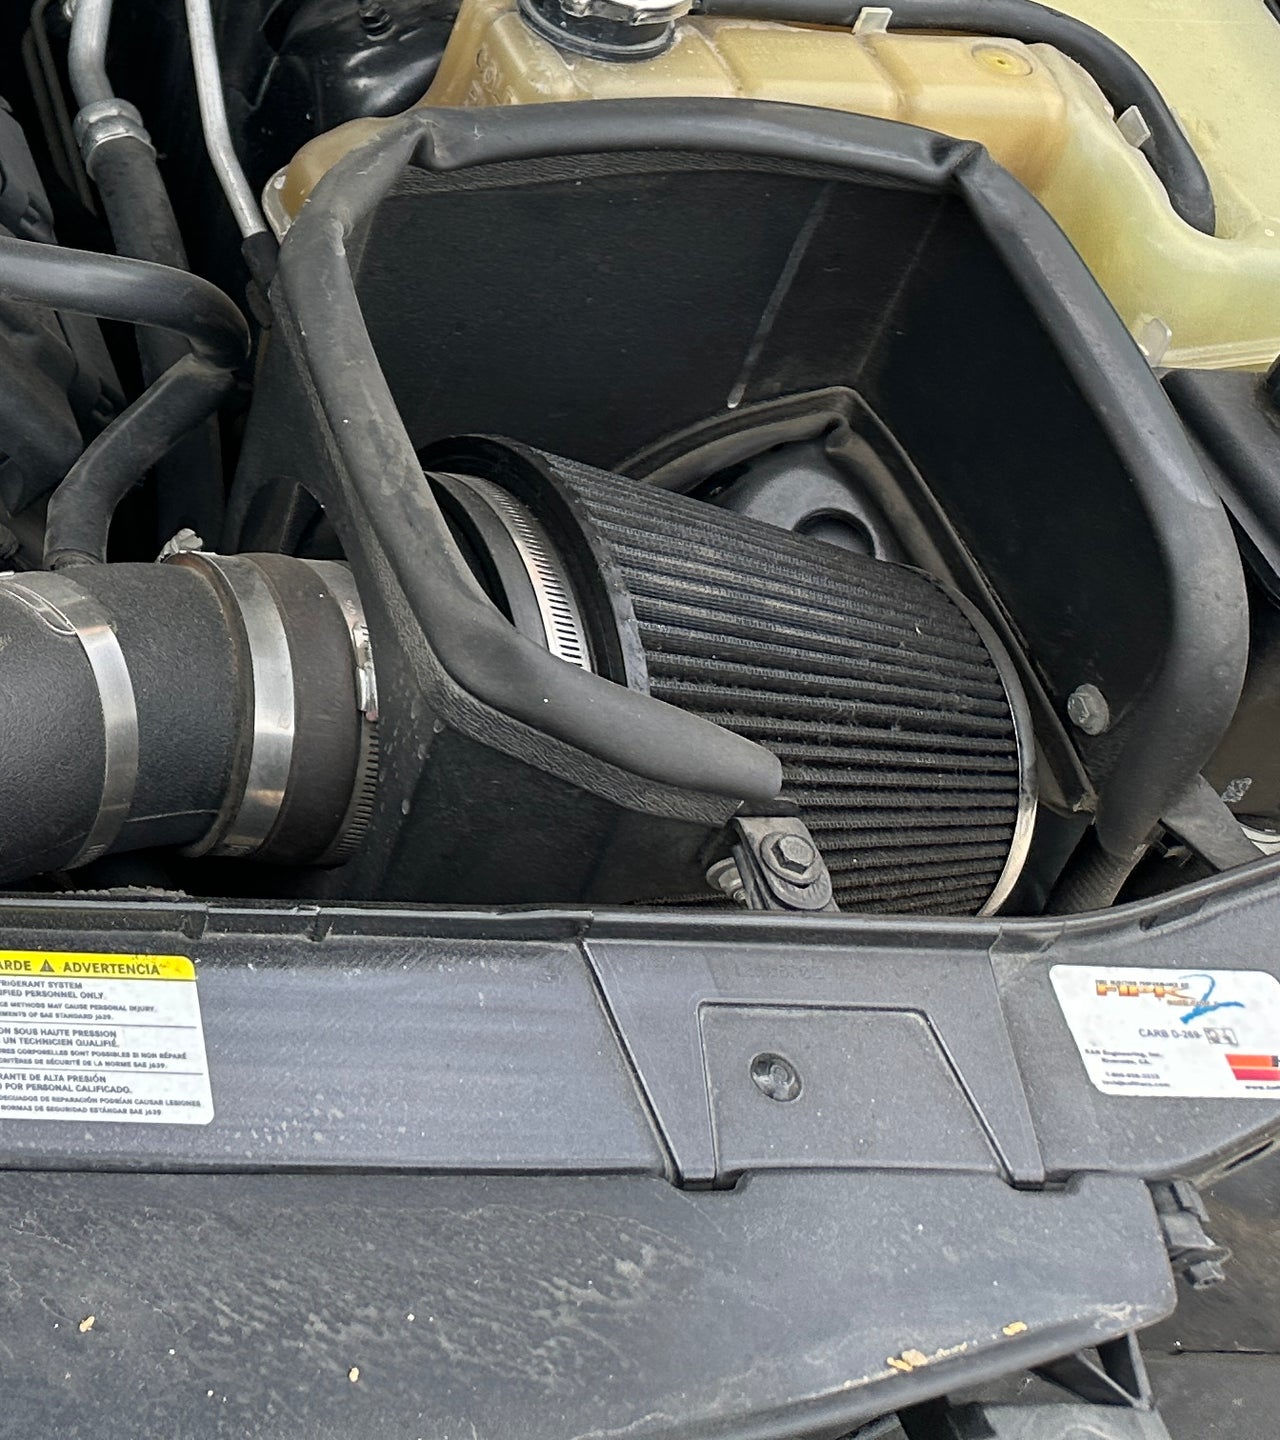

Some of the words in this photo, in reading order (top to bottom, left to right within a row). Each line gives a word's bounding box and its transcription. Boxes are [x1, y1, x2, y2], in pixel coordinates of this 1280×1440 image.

[63, 962, 160, 975] ADVERTENCIA
[47, 981, 83, 990] SYSTEM
[24, 989, 78, 999] PERSONNEL
